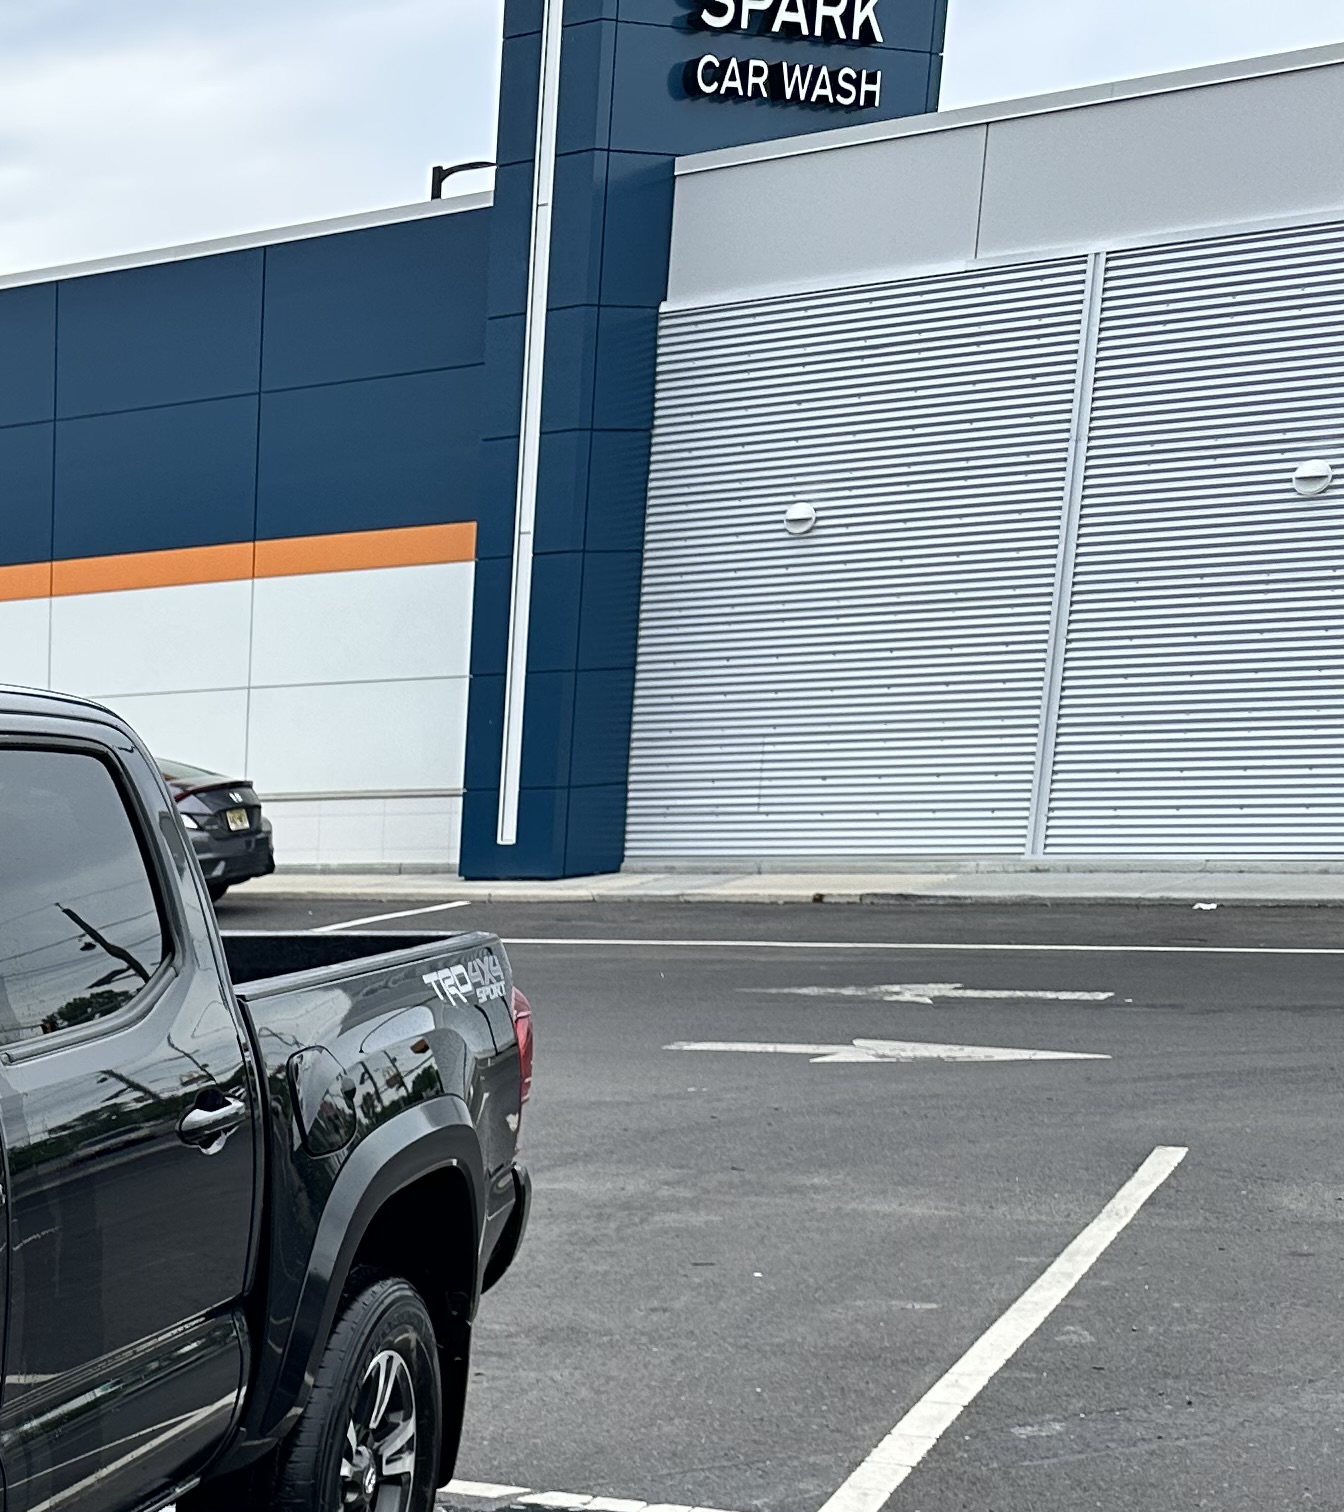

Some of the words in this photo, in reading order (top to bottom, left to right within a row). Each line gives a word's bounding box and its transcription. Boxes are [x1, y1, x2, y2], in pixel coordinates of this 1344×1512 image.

[696, 54, 768, 98] CAR
[782, 61, 882, 107] WASH
[422, 964, 472, 1007] TRD
[475, 980, 507, 1004] SPORT
